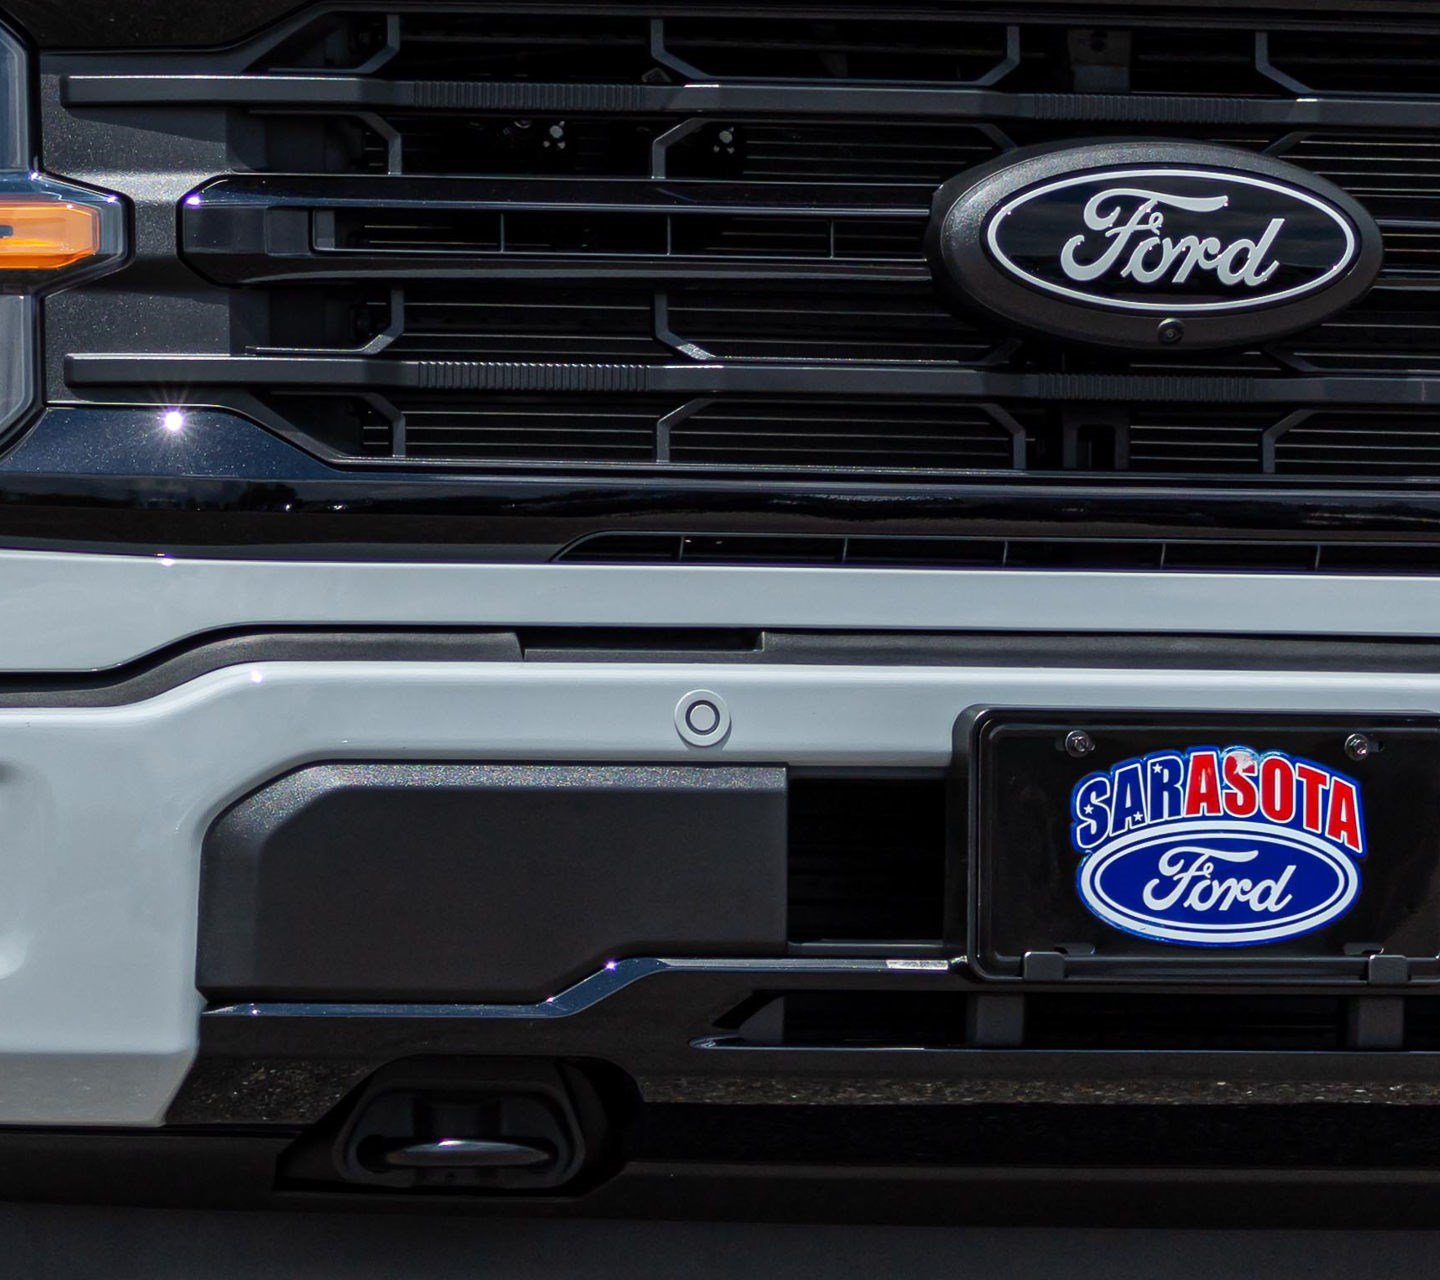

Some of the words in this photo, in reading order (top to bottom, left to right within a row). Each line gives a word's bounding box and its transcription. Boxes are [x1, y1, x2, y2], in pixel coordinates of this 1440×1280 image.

[1060, 187, 1286, 287] Ford
[1075, 750, 1363, 854] SARASOTA
[1142, 845, 1297, 913] Ford
